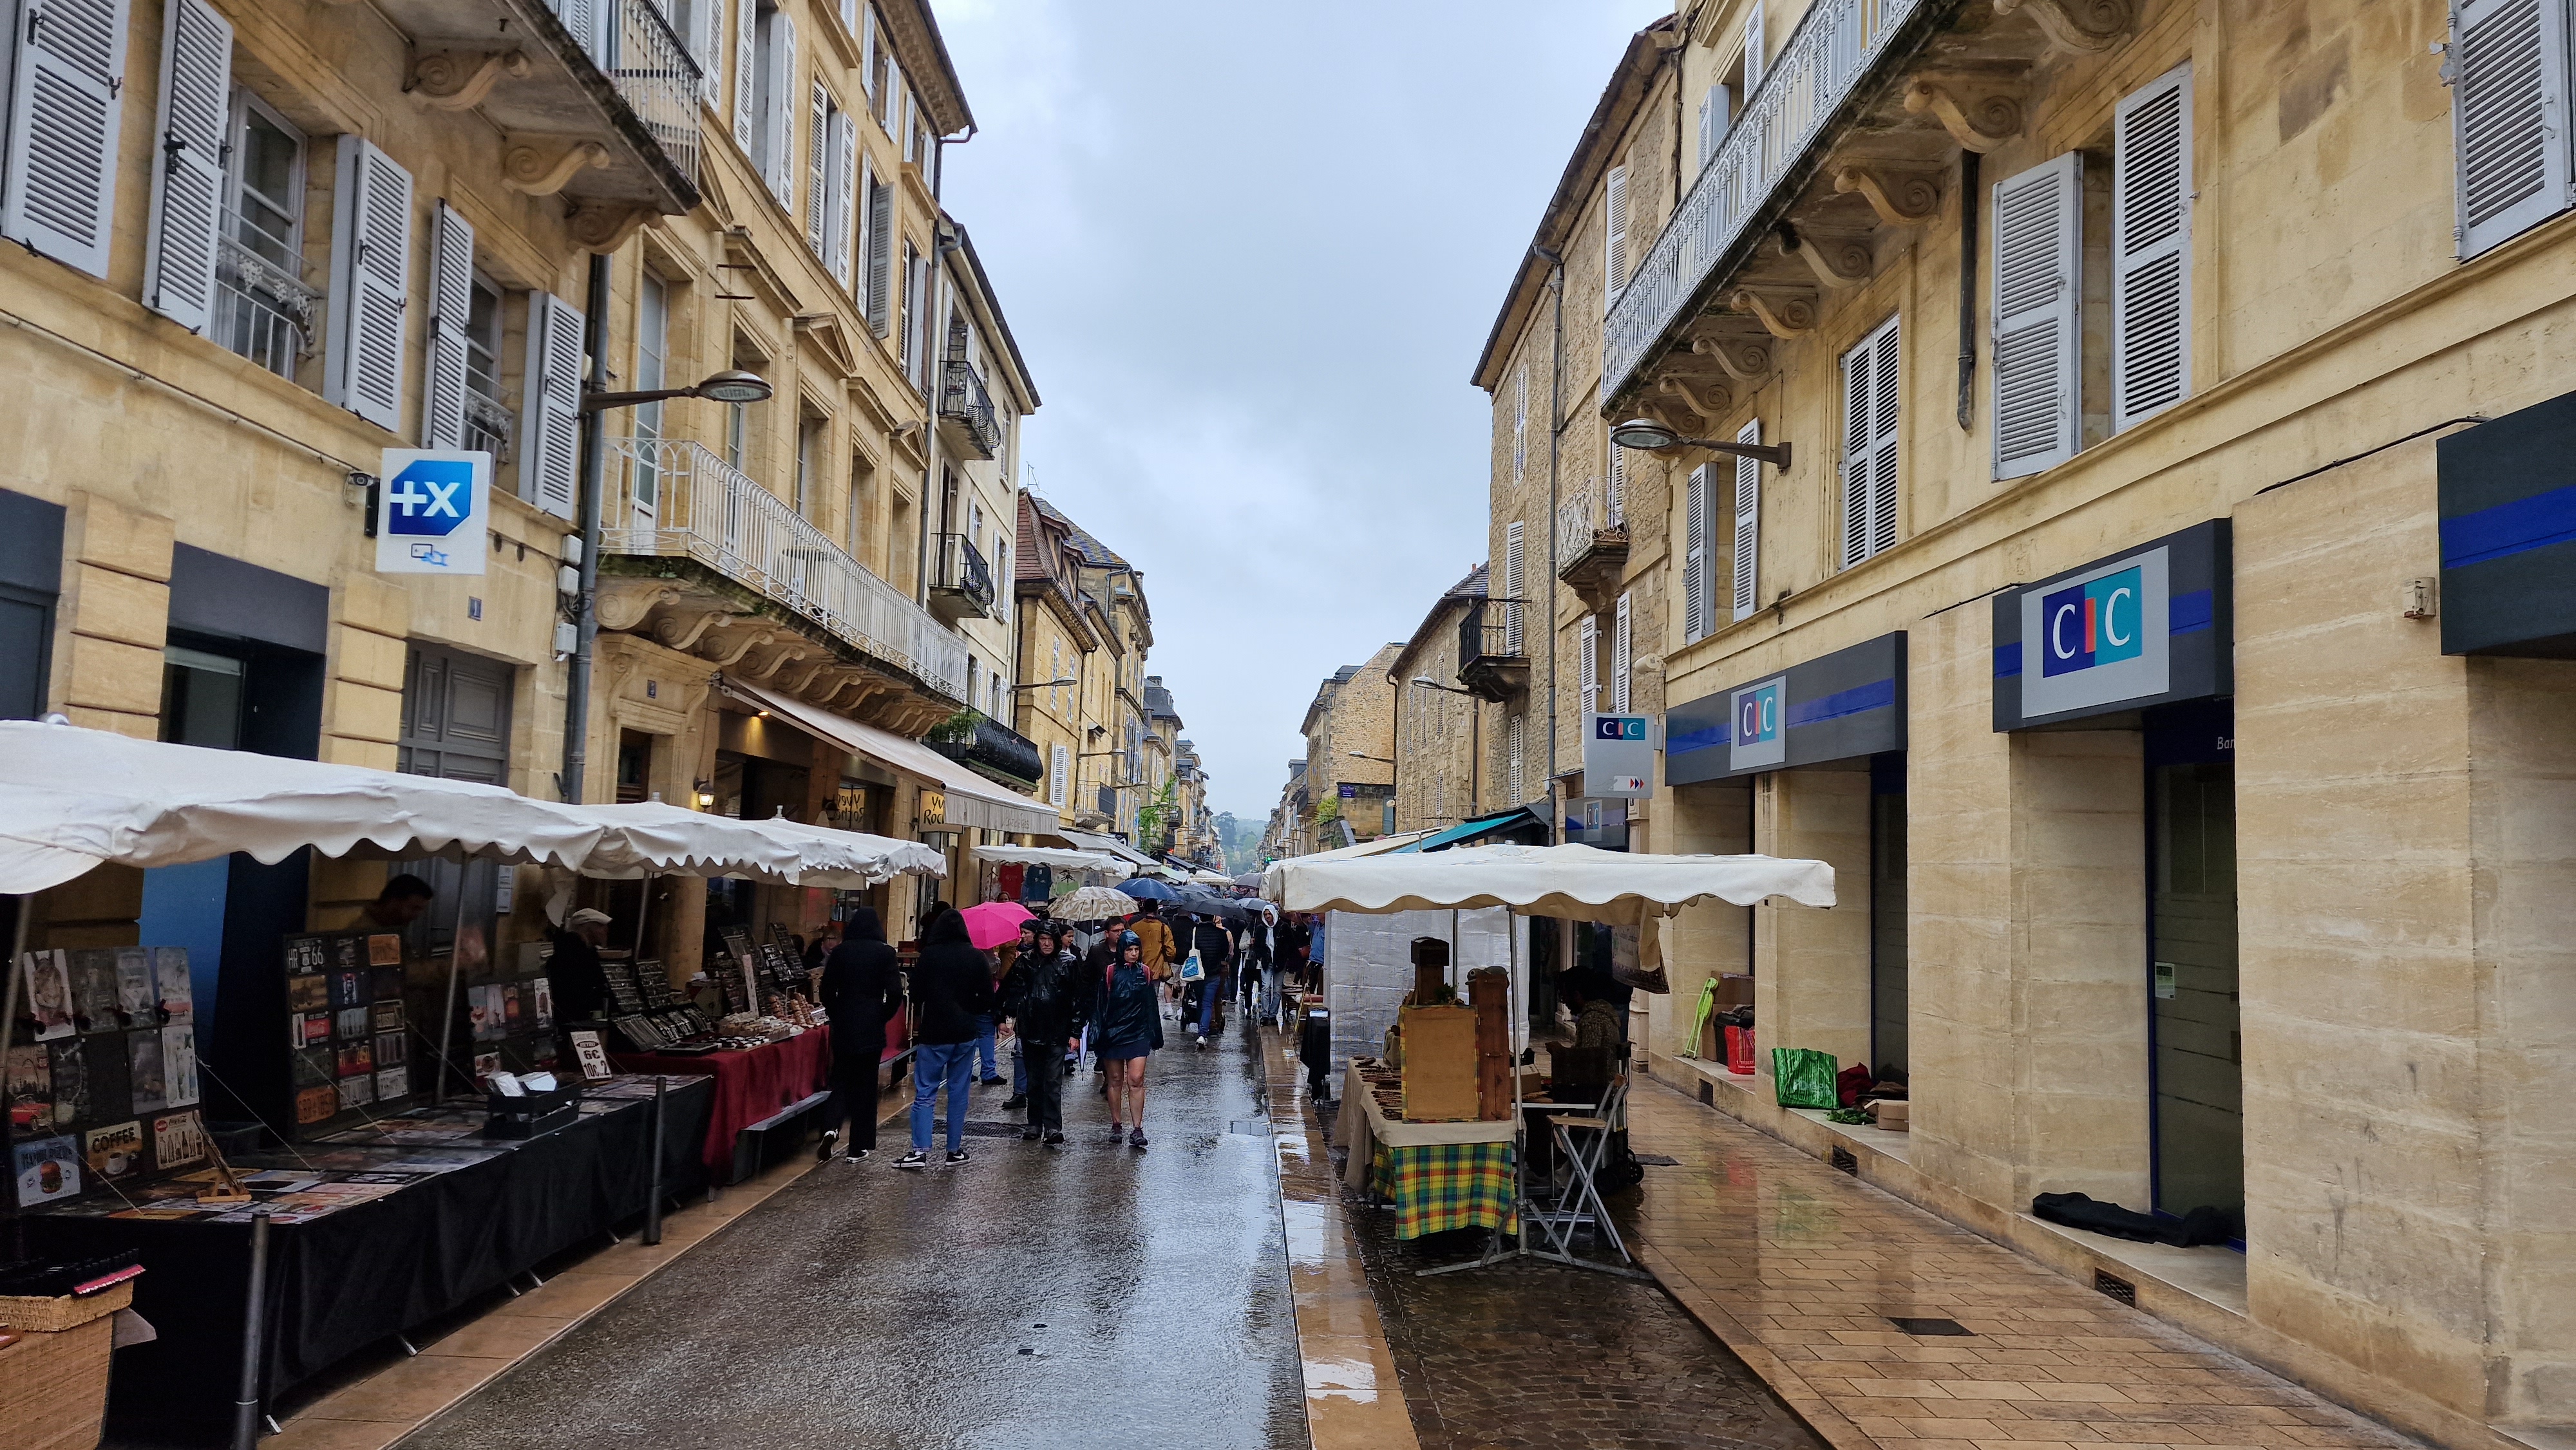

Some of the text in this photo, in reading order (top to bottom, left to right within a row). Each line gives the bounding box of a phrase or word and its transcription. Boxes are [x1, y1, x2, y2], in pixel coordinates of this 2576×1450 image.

[2052, 587, 2130, 659] CIC
[1743, 696, 1773, 737] CIC
[1602, 721, 1639, 736] CIC
[931, 796, 945, 811] Yv
[923, 809, 945, 825] Roc
[312, 946, 323, 966] 66
[600, 1060, 611, 1075] 2
[92, 1127, 137, 1153] COFFEE
